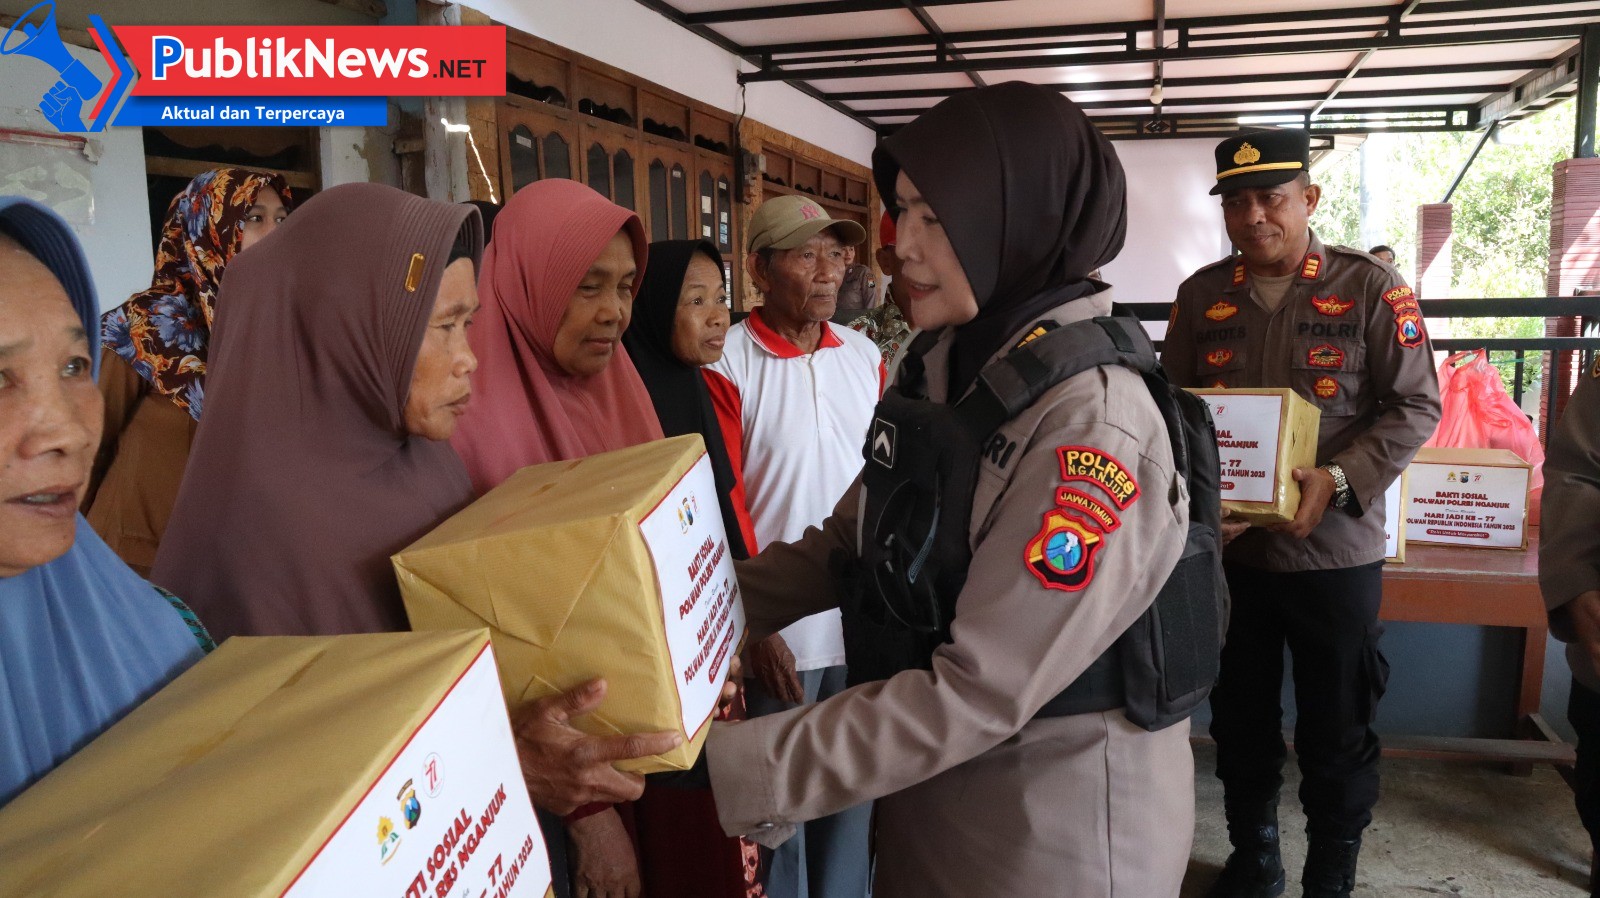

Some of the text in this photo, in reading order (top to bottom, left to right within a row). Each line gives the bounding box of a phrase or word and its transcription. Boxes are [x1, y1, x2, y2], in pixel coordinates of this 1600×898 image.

[1298, 322, 1358, 338] POLRI
[1067, 450, 1135, 495] POLRES
[1228, 469, 1250, 477] TAHUN
[1250, 470, 1265, 478] 2025
[1229, 459, 1242, 467] 77
[1068, 464, 1128, 502] NGANJUK
[1060, 493, 1113, 526] JAWA TIMUR
[1413, 497, 1446, 505] POLWAN
[687, 552, 703, 582] BAKTI
[679, 580, 702, 620] POLWAN
[427, 807, 472, 881] SOSIAL
[458, 783, 507, 870] NGANJUK
[518, 834, 533, 869] 2025
[488, 852, 503, 887] 77
